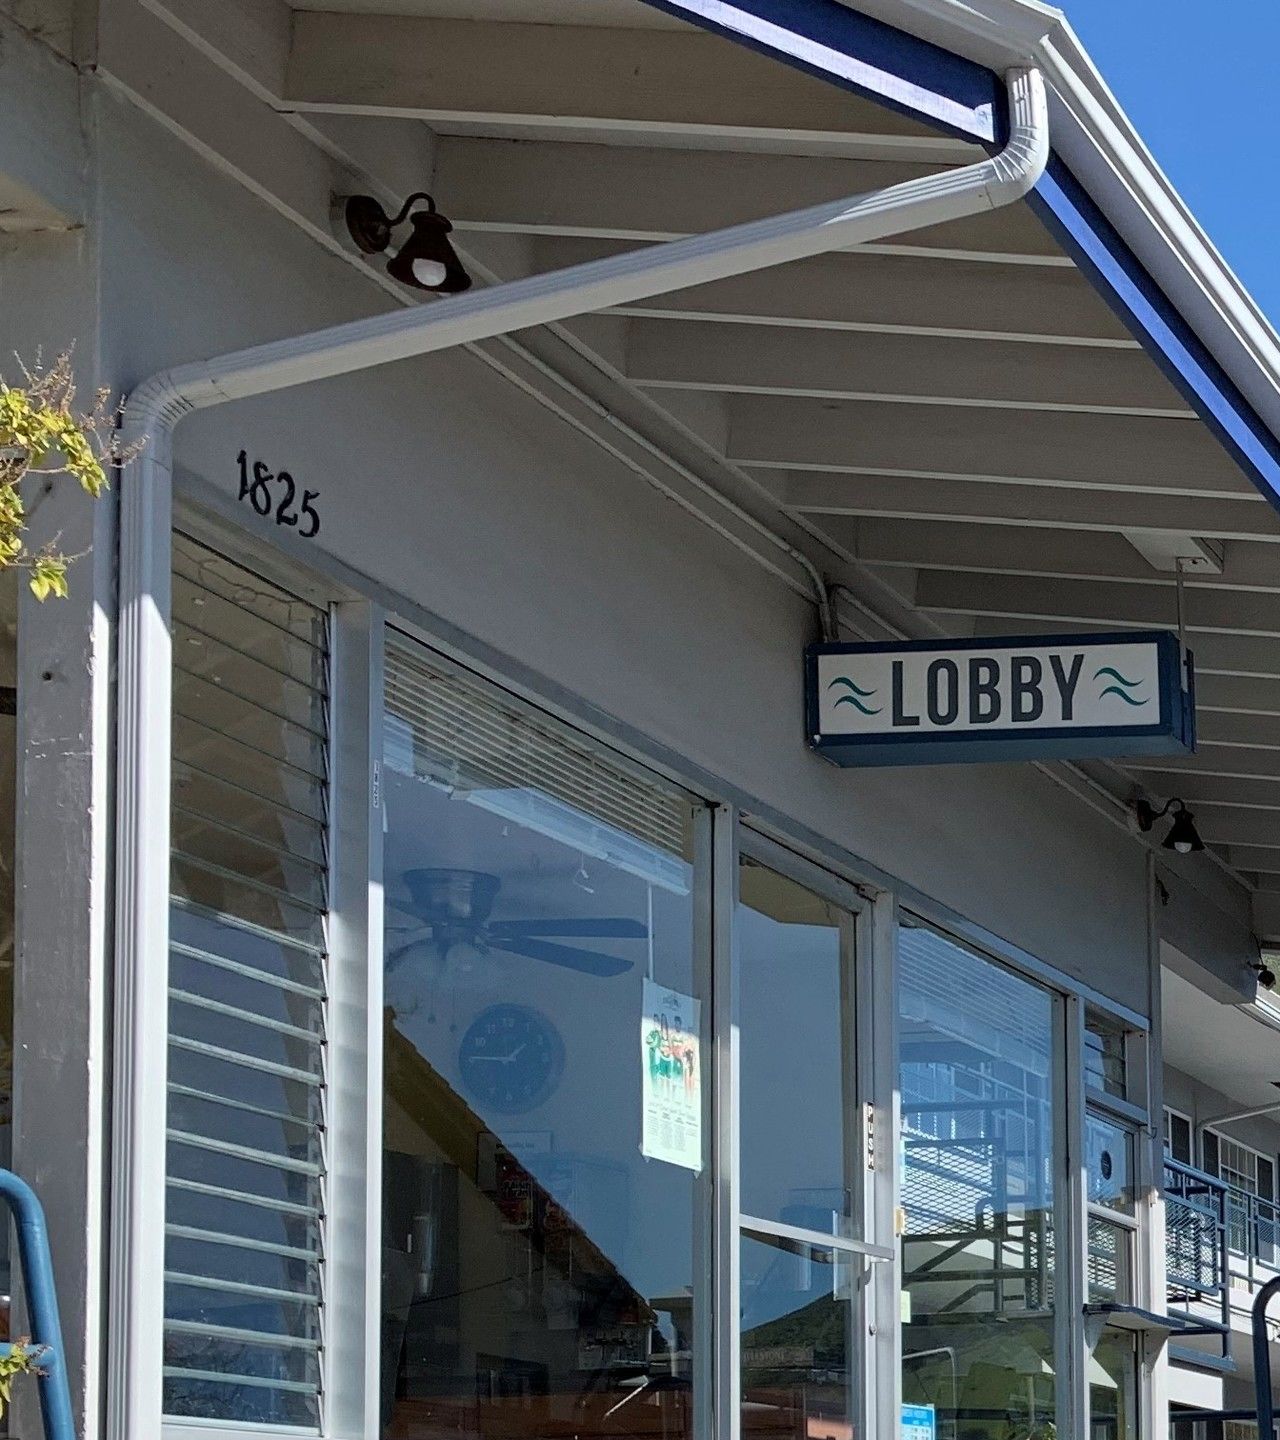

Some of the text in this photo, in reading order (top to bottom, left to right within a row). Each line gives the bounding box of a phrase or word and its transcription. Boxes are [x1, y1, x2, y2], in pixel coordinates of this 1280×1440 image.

[236, 449, 321, 538] 1825
[891, 653, 1085, 727] LOBBY
[867, 1105, 875, 1167] PUSH
